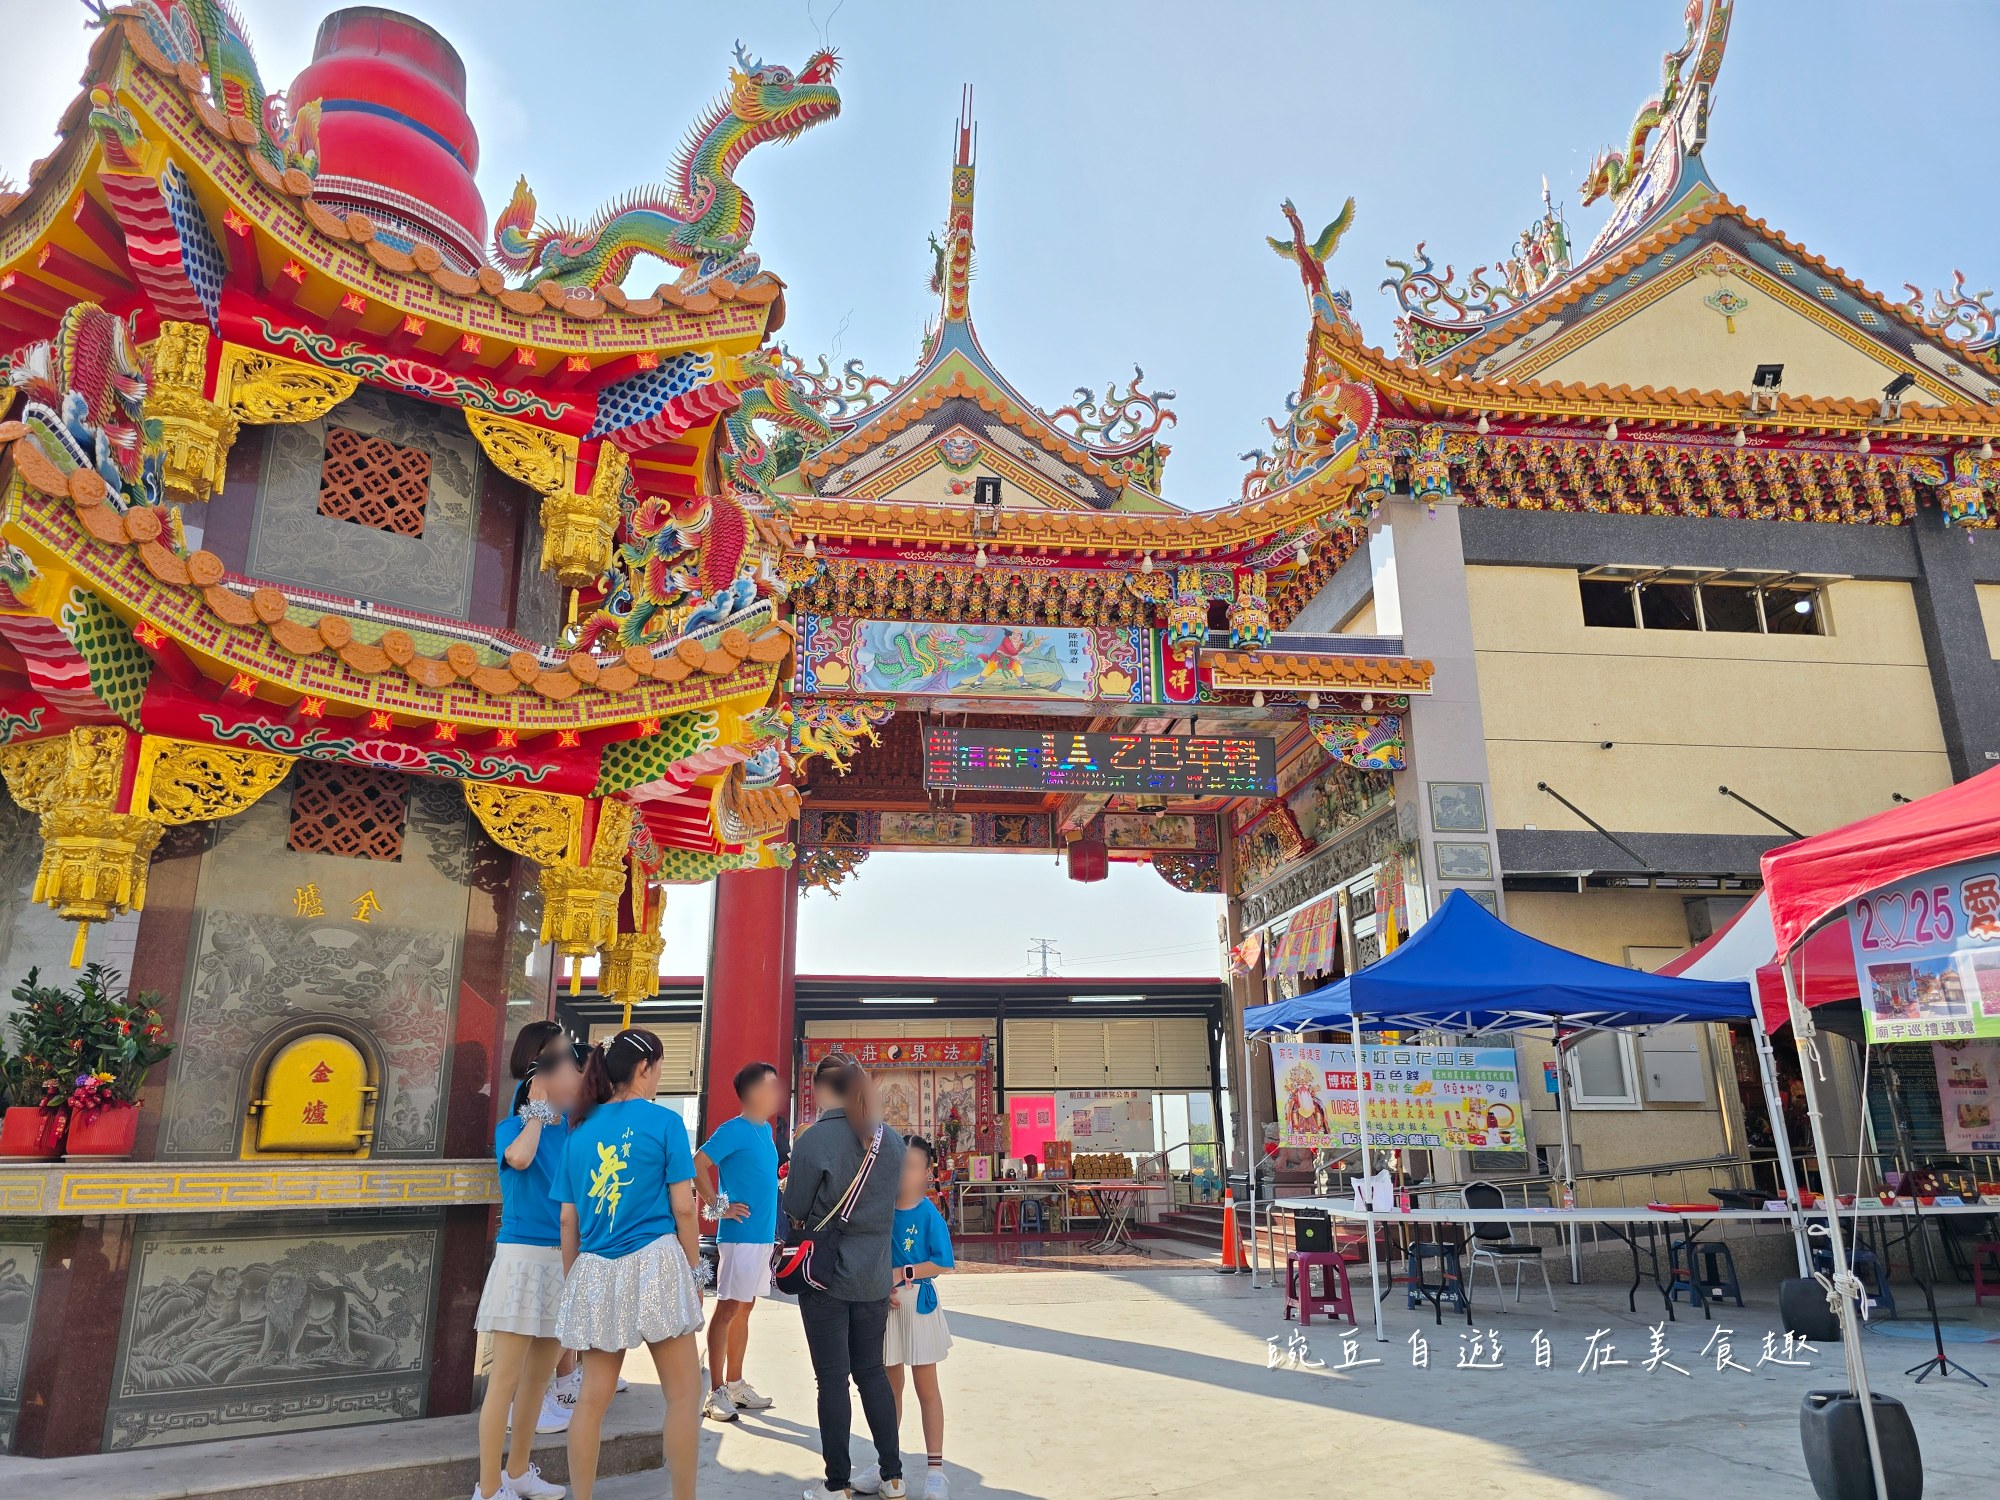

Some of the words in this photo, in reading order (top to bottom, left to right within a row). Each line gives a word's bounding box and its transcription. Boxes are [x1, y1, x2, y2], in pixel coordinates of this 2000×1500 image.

[1068, 632, 1079, 664] 降龍尊者
[1874, 1020, 1976, 1039] 廟宇巡禮導覽
[301, 1060, 334, 1124] 金爐
[620, 1127, 634, 1158] 小賀
[902, 1223, 918, 1252] 小賀
